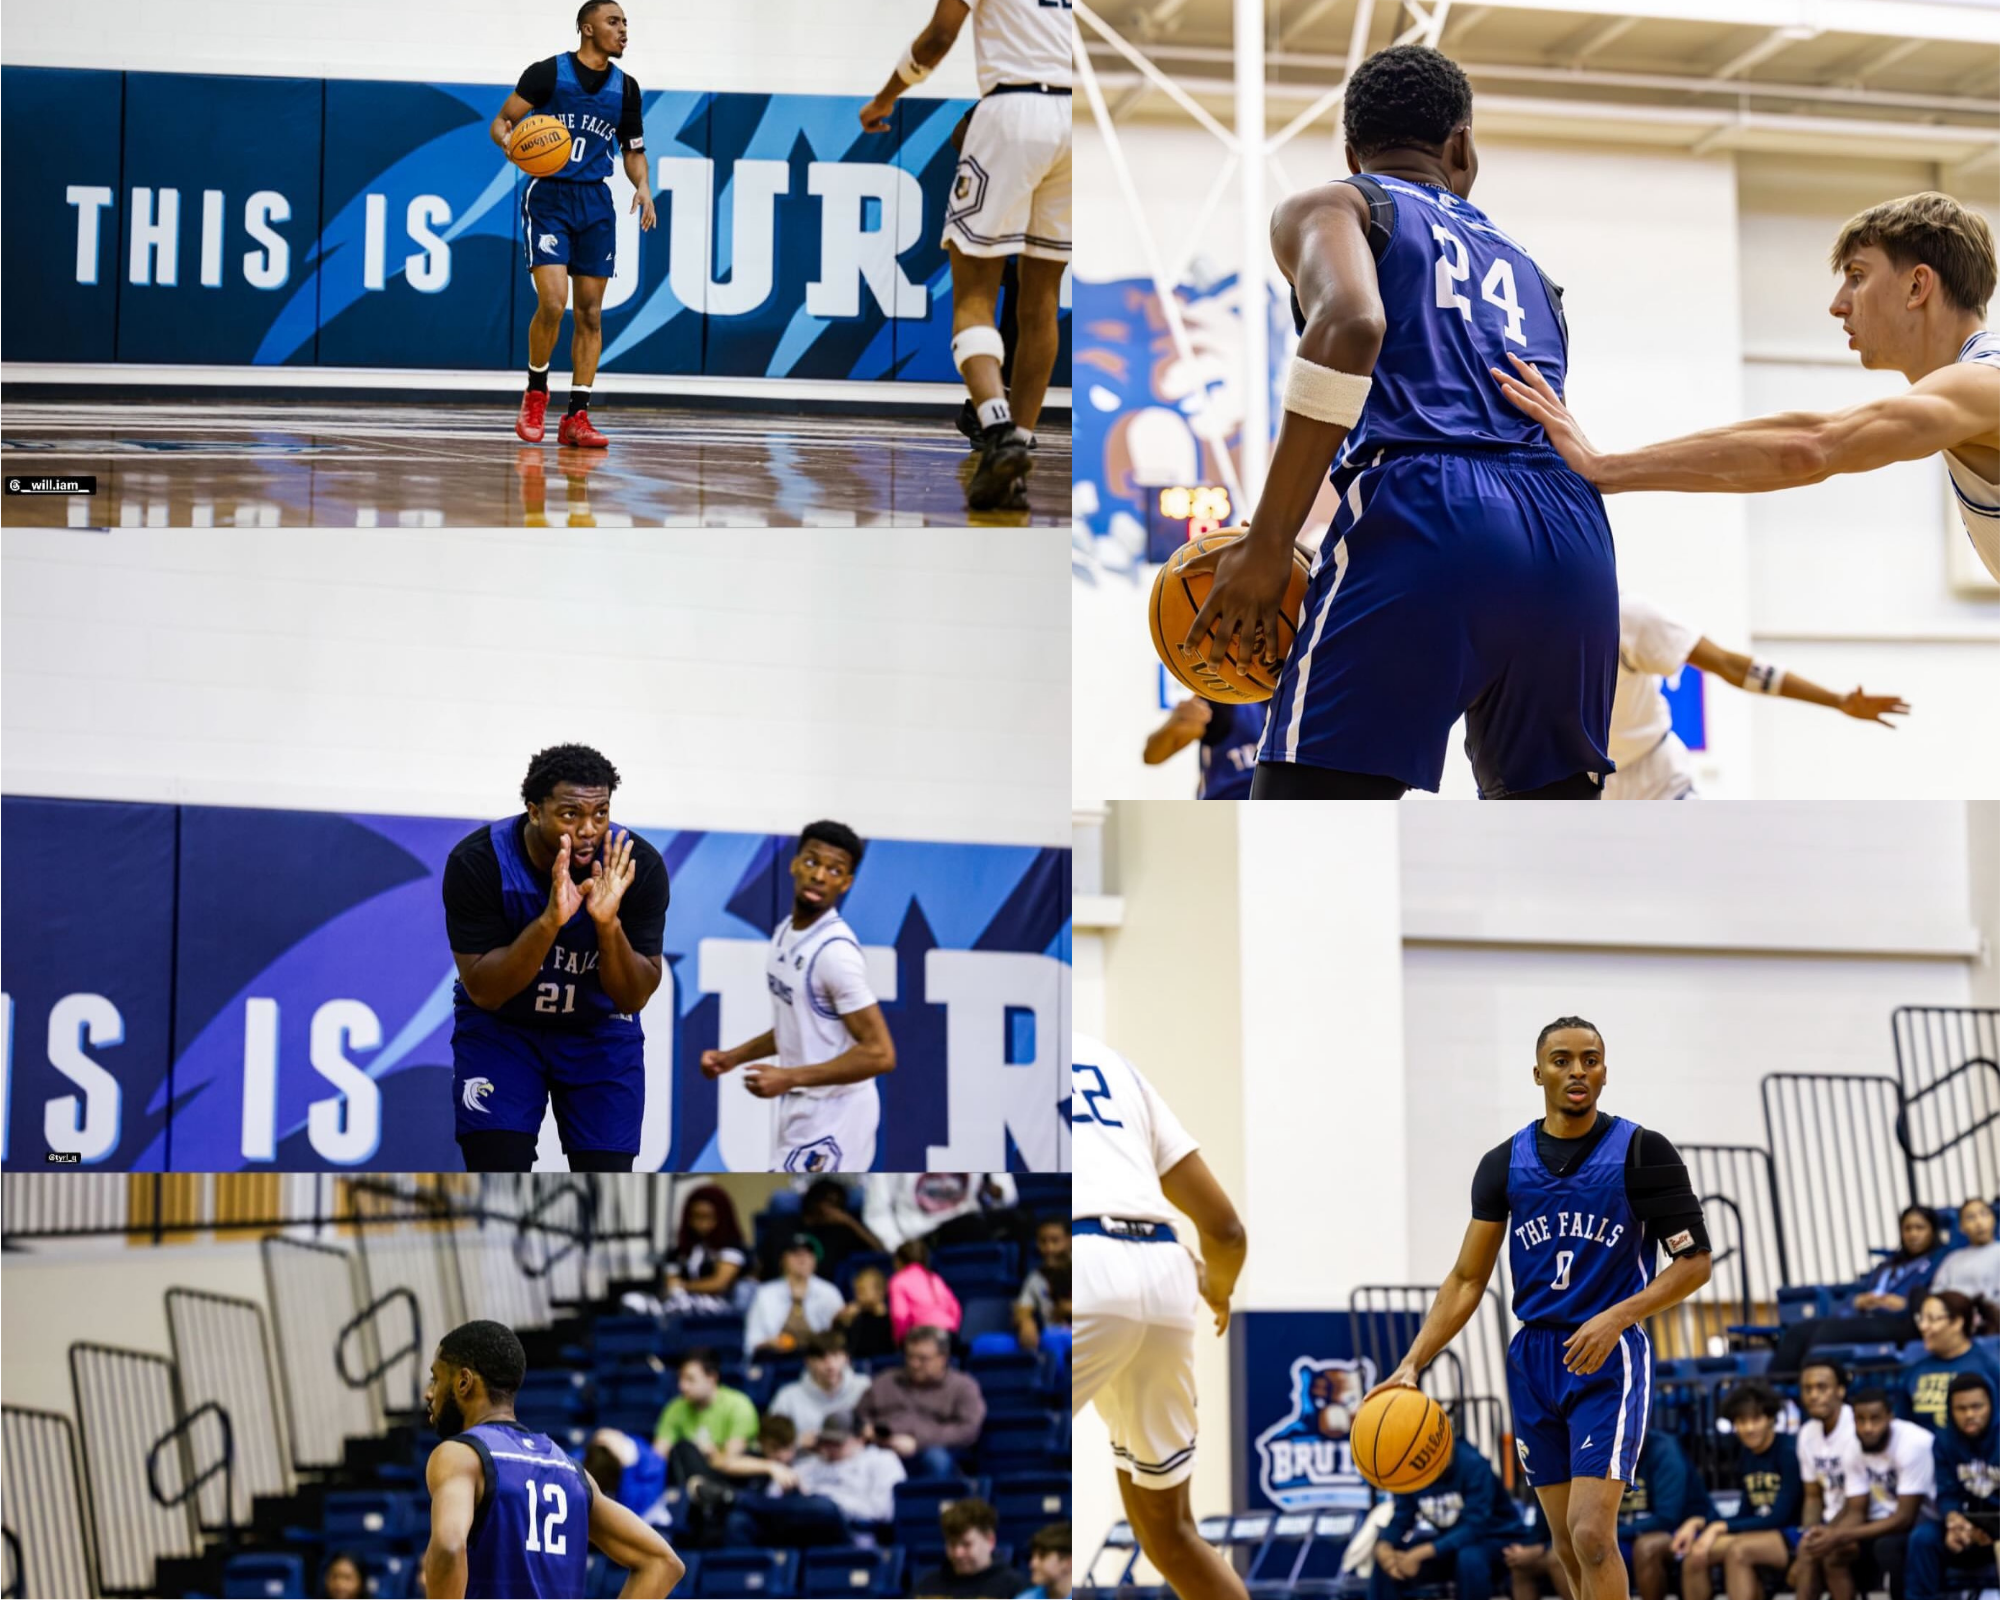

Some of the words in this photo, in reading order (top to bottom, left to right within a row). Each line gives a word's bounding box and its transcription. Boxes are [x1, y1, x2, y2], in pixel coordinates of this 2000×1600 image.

[520, 131, 561, 152] Wilson
[551, 113, 575, 129] HE
[581, 115, 616, 142] FALLS
[570, 137, 586, 163] 0
[66, 185, 291, 290] THIS
[364, 193, 452, 293] IS
[1432, 223, 1527, 348] 24
[535, 982, 576, 1014] 21
[241, 997, 382, 1166] IS
[1515, 1215, 1552, 1251] THE
[1558, 1211, 1624, 1248] FALLS
[1550, 1250, 1575, 1291] 0
[525, 1478, 568, 1556] 12
